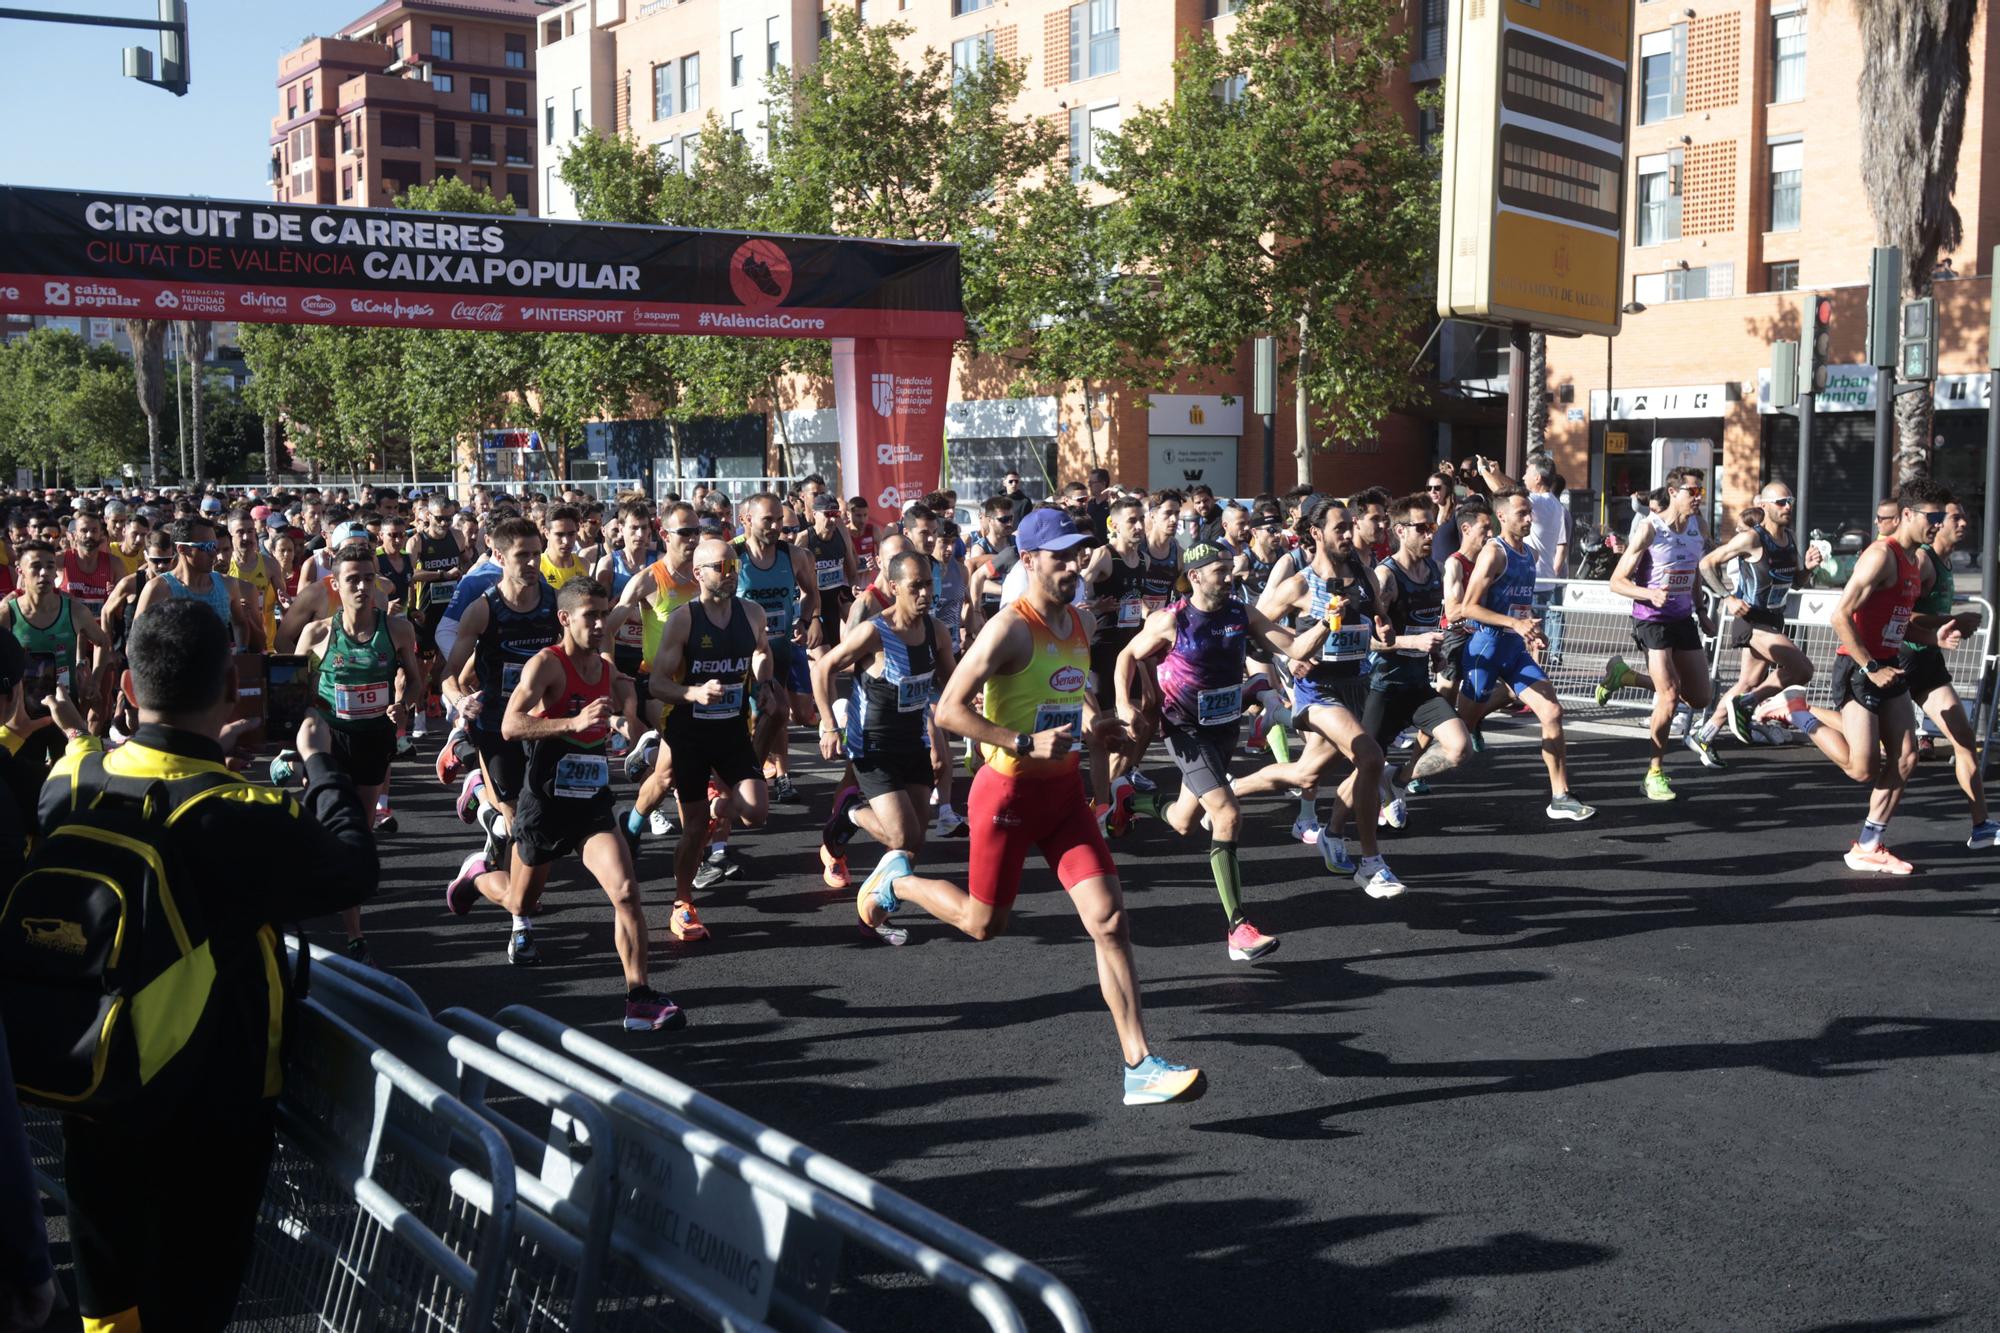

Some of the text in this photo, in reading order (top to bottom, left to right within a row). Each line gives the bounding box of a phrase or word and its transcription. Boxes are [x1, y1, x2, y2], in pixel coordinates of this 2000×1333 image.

[85, 201, 504, 253] CIRCUIT DE CARRERES
[86, 241, 356, 275] CIUTAT DE VALÈNCIA
[363, 251, 640, 291] CAIXA POPULAR
[75, 284, 117, 296] caixa
[75, 295, 141, 309] popular
[181, 295, 225, 305] TRINIDAD
[240, 291, 287, 307] divina
[181, 304, 225, 313] ALFONSO
[536, 307, 624, 324] INTERSPORT
[644, 311, 680, 321] aspaym
[698, 312, 825, 330] #ValènciaCorre
[1815, 389, 1867, 405] nning
[425, 557, 459, 569] REDOLAT
[1332, 631, 1361, 647] 2514
[691, 657, 749, 674] REDOLAT
[1053, 674, 1084, 687] Serrano
[357, 691, 377, 704] 19
